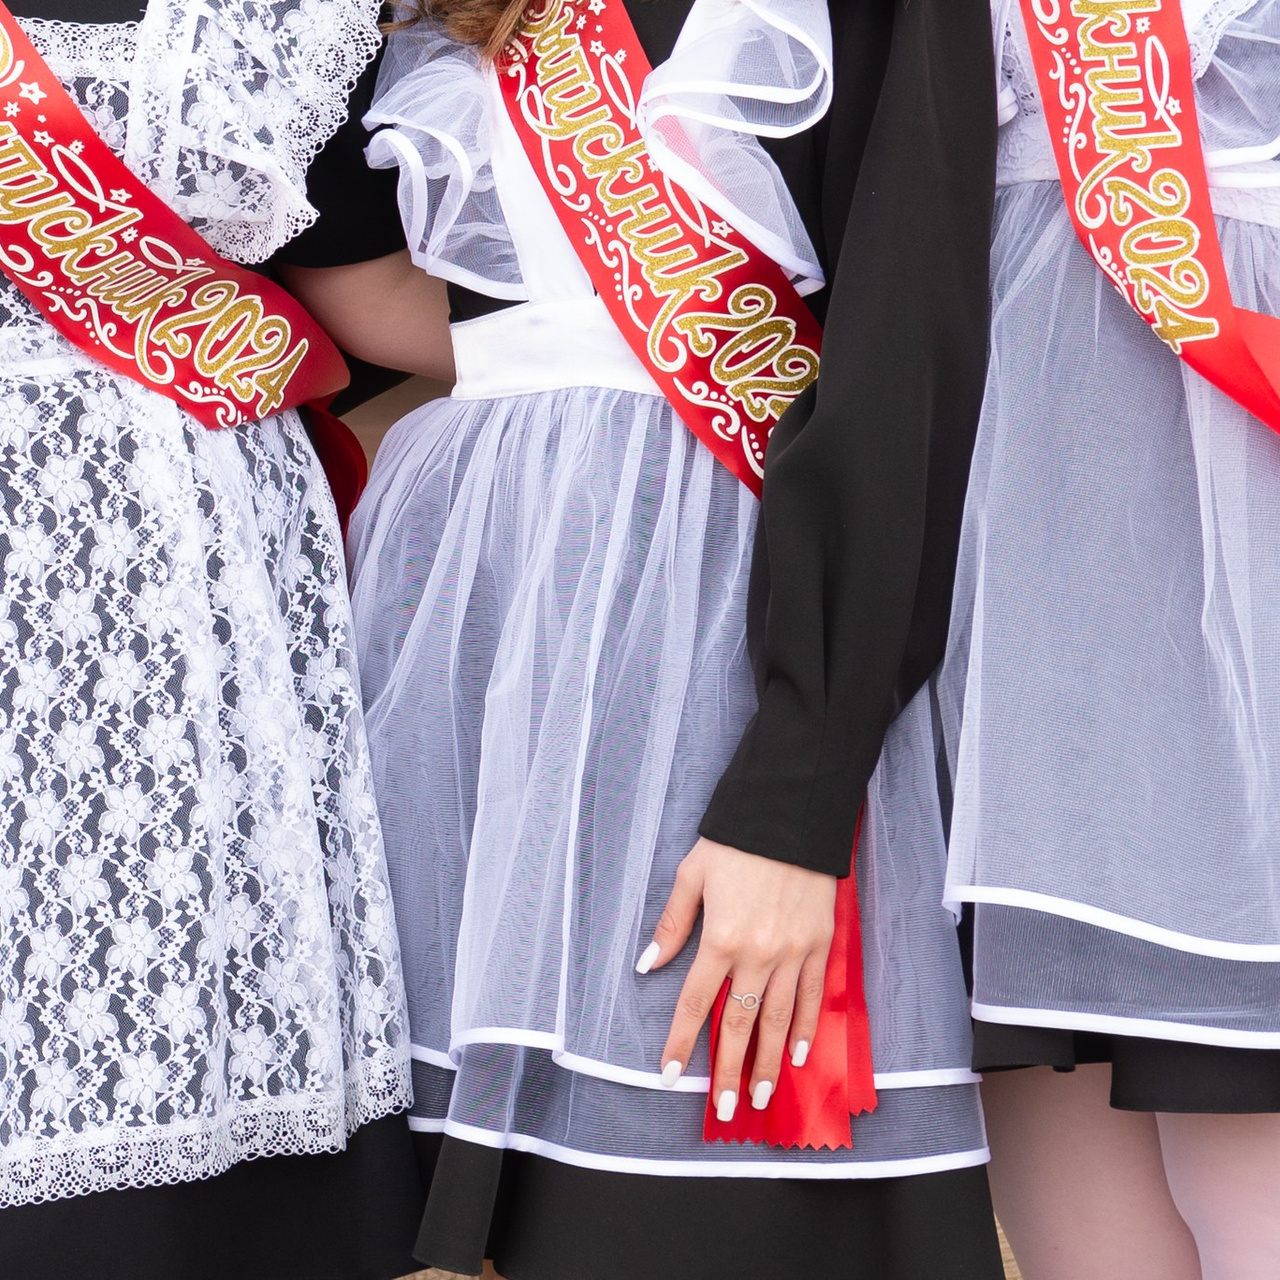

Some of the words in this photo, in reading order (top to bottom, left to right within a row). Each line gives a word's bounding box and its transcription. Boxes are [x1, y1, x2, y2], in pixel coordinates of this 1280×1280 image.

[1105, 168, 1219, 355] 2024
[150, 279, 310, 418] 2024
[671, 282, 820, 423] 202
